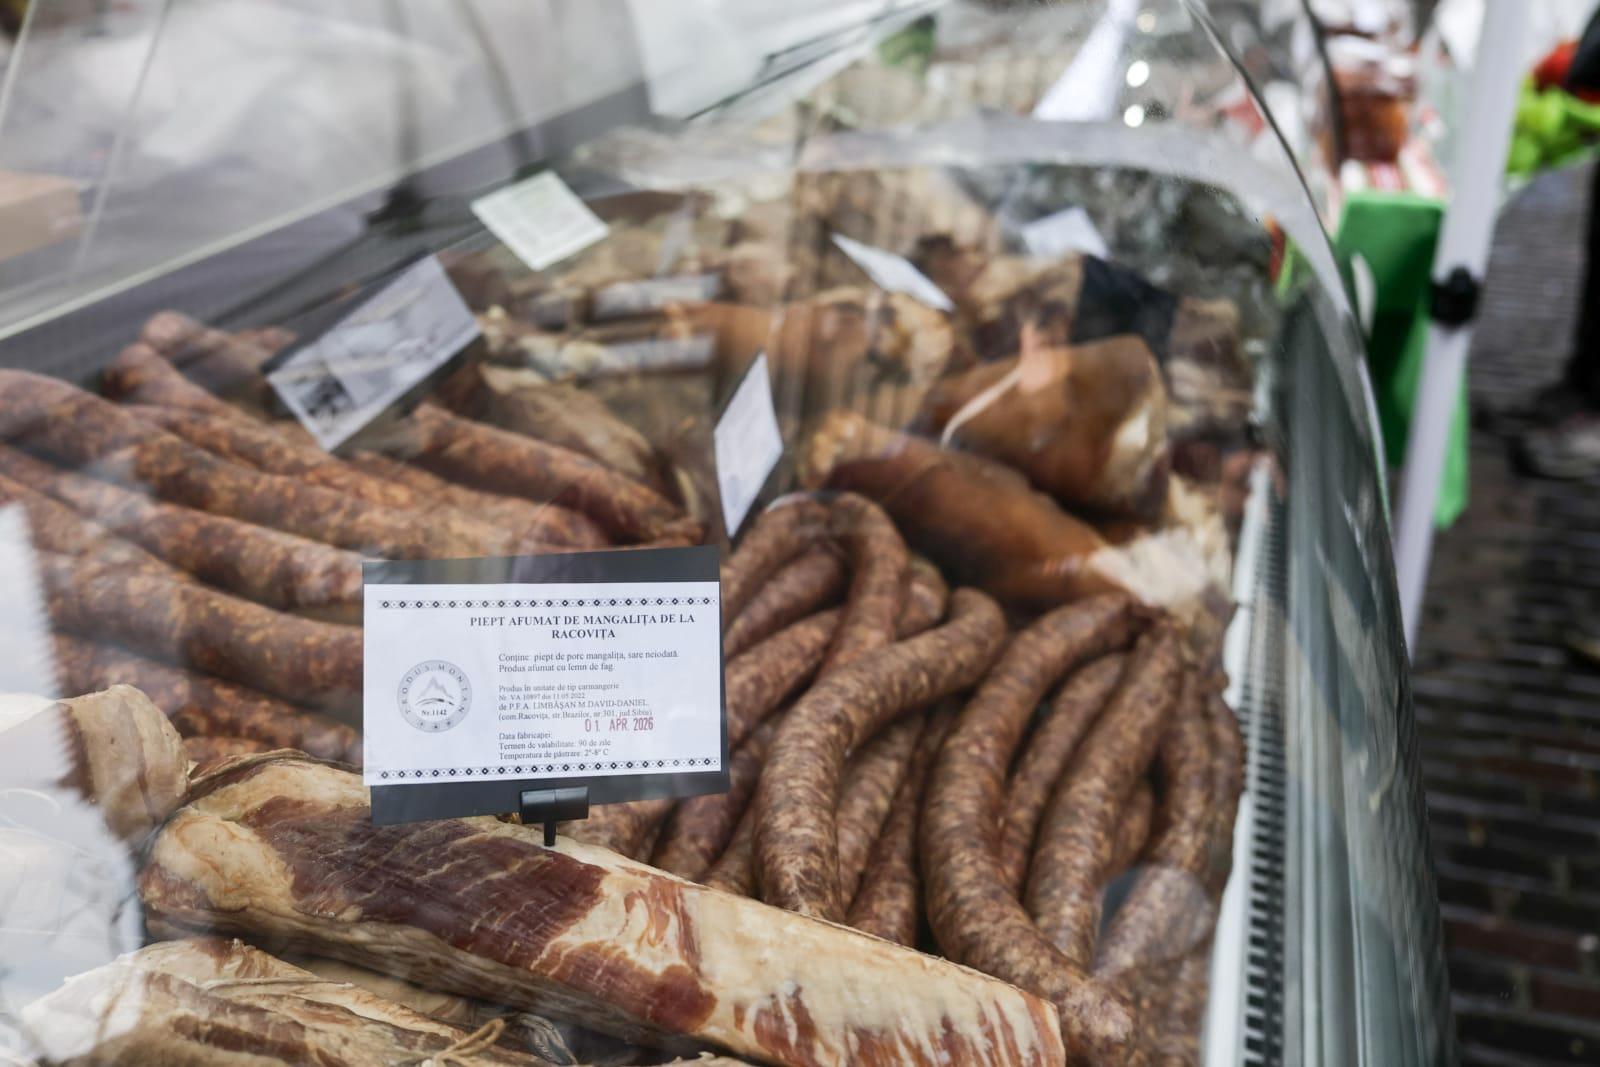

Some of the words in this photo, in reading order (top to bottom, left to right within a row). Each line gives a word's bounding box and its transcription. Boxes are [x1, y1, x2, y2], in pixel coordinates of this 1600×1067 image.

[470, 616, 505, 627] PIEPT
[508, 616, 560, 626] AFUMAT
[564, 615, 581, 625] DE
[583, 614, 657, 627] MANGALIȚA
[660, 614, 676, 624] DE
[679, 613, 695, 624] LA
[552, 628, 616, 640] RACOVIȚA
[534, 652, 554, 663] piept
[555, 652, 565, 661] de
[566, 653, 585, 663] porc
[628, 651, 645, 659] sare
[499, 663, 526, 673] Produs
[527, 663, 555, 672] afumat
[568, 662, 588, 671] lemn
[589, 662, 599, 670] de
[600, 662, 615, 672] fag.
[498, 685, 522, 693] Produs
[557, 683, 566, 691] de
[567, 683, 577, 692] tip
[578, 683, 620, 692] carmangerie
[498, 703, 508, 711] de
[633, 717, 654, 731] 2026
[499, 742, 526, 750] Termen
[527, 741, 536, 749] de
[588, 739, 598, 747] de
[499, 752, 544, 761] Temperatura
[545, 751, 553, 759] de
